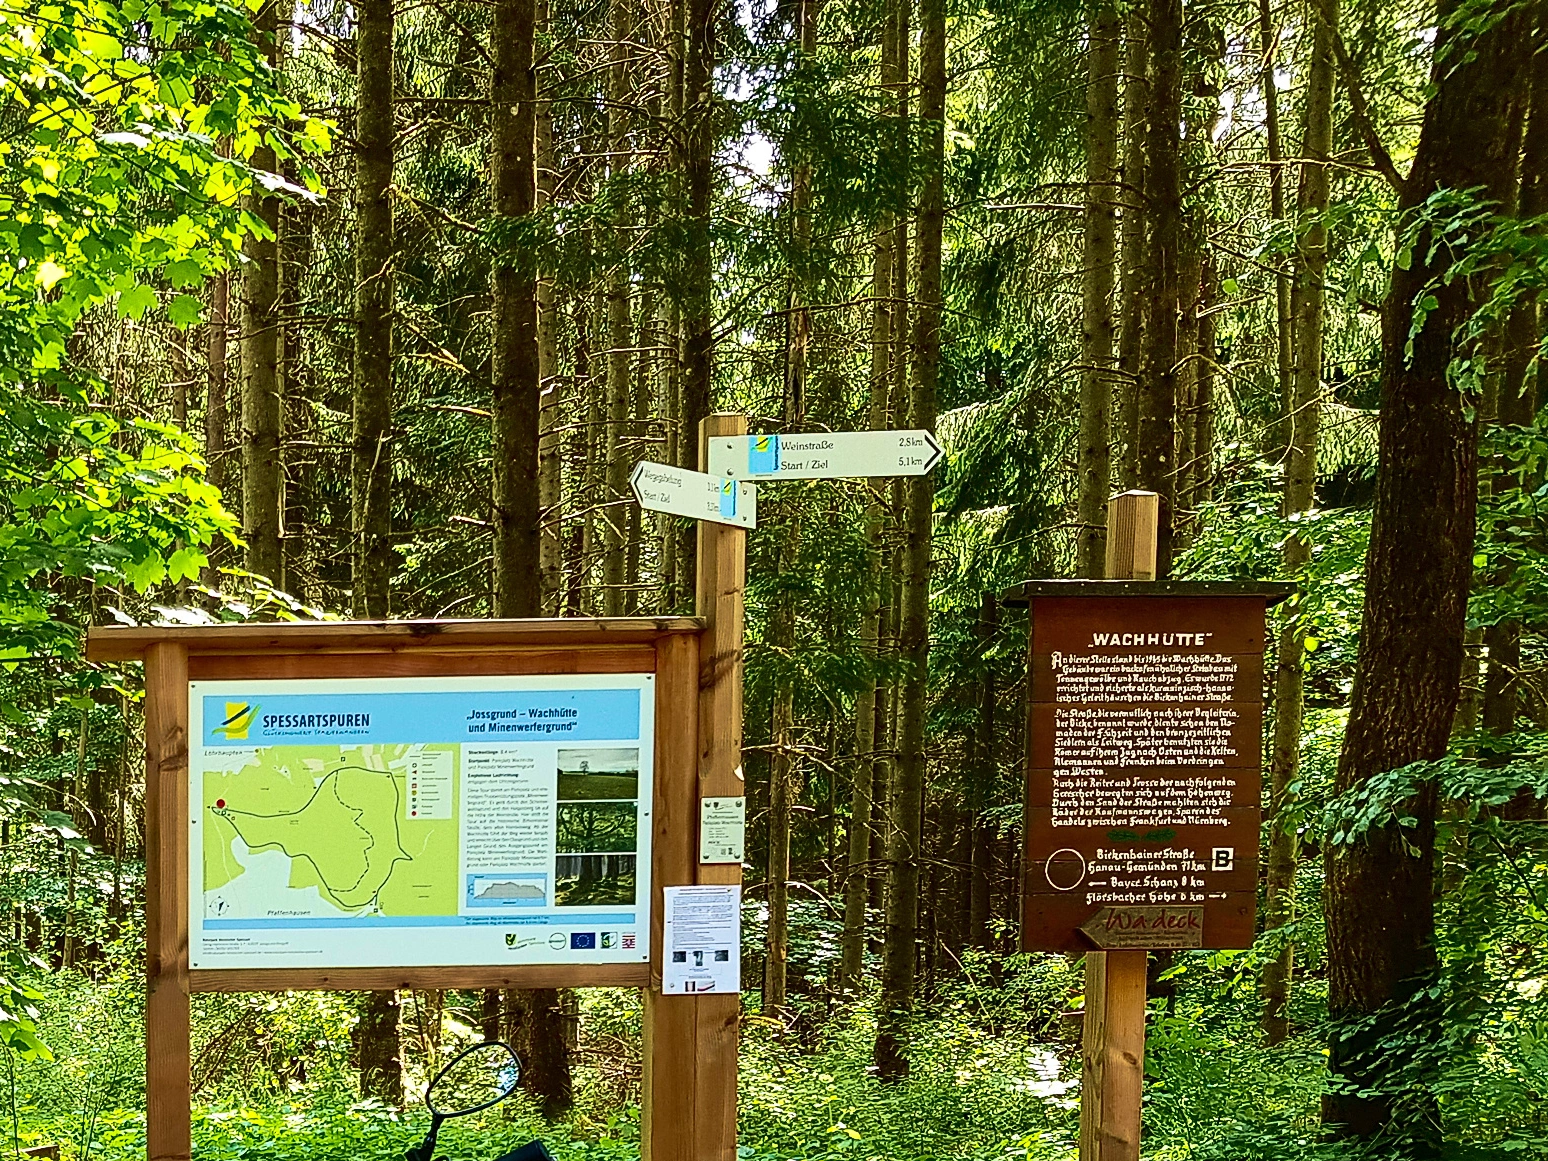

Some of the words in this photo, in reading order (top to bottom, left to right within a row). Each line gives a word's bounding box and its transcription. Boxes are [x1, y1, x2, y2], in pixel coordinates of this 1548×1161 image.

[781, 440, 834, 450] Weinstraße
[781, 460, 803, 470] Start
[812, 460, 828, 469] Ziel
[1112, 654, 1132, 663] stand
[1224, 664, 1238, 673] mit
[1117, 674, 1132, 682] und
[1090, 683, 1104, 692] und
[528, 707, 577, 718] Wachhütte
[1054, 708, 1068, 718] Die
[1154, 708, 1173, 718] nach
[263, 713, 370, 728] SPESSARTSPUREN
[1205, 718, 1219, 727] den
[468, 723, 486, 733] und
[1133, 728, 1149, 736] und
[1150, 727, 1164, 736] den
[1137, 747, 1157, 757] nach
[1159, 747, 1183, 756] Osten
[1103, 756, 1118, 765] und
[1119, 756, 1155, 767] Franken
[1053, 769, 1069, 777] gen
[1075, 778, 1088, 787] die
[1115, 778, 1131, 787] und
[1080, 798, 1094, 806] den
[1096, 798, 1117, 806] Sand
[1119, 798, 1132, 806] der
[1129, 816, 1171, 826] Frankfurt
[1172, 816, 1186, 824] und
[1096, 848, 1162, 860] Birkenhainer
[1162, 847, 1195, 860] Straße
[1088, 861, 1178, 874] Hanau-Gemünden
[1143, 875, 1178, 888] Schanz
[1190, 876, 1205, 887] km
[1086, 892, 1146, 905] Flörsbacher
[1149, 890, 1176, 903] Höhe
[1190, 892, 1205, 901] km
